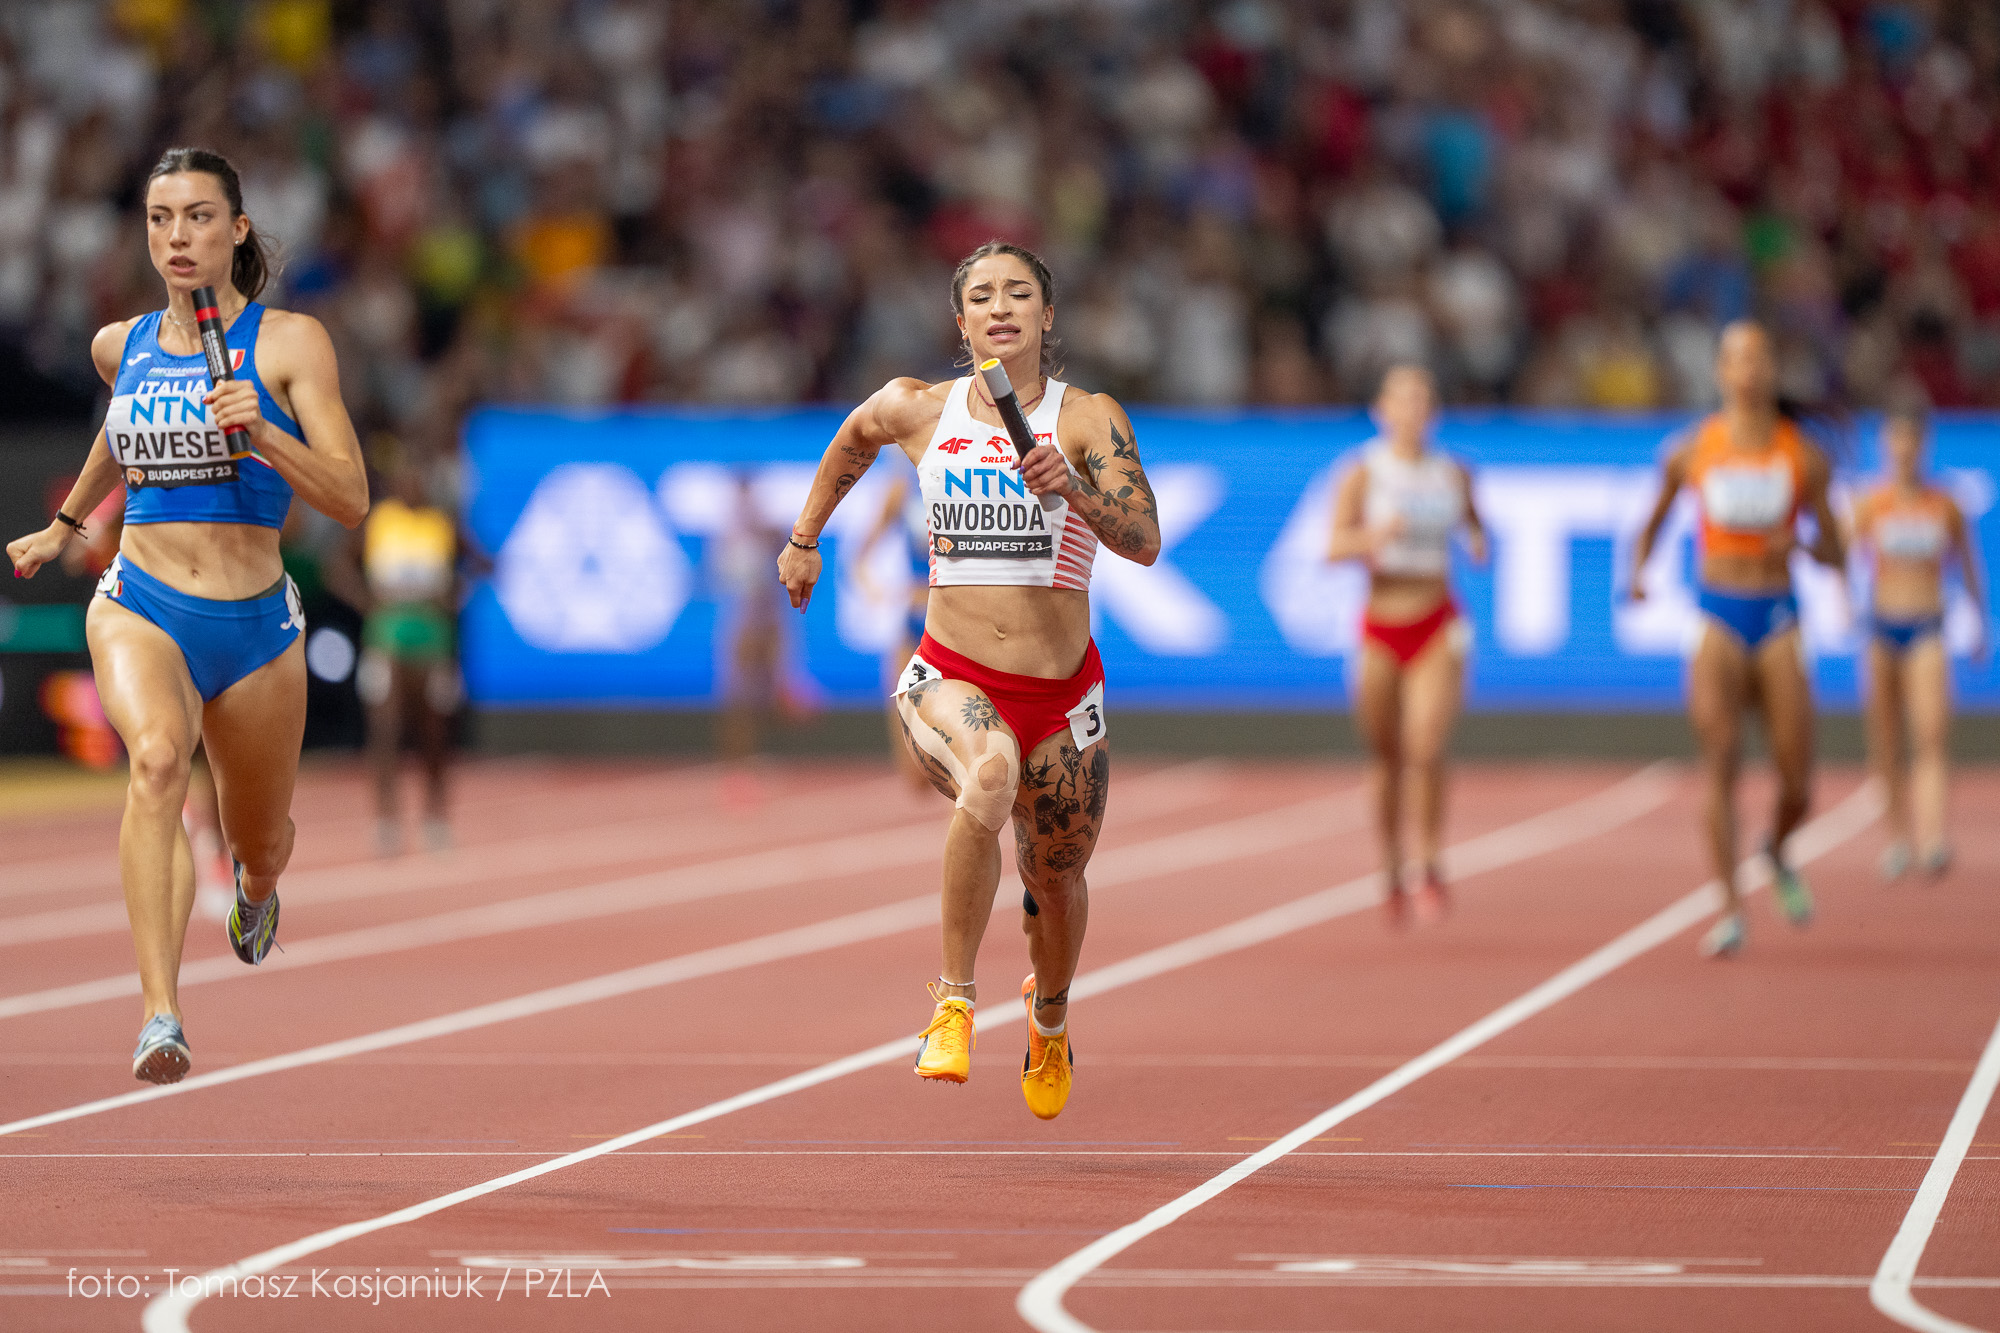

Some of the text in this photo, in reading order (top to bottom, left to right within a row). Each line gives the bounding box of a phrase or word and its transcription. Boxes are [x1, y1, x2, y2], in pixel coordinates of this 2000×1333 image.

[135, 380, 208, 396] ITALIA
[130, 396, 206, 425] NTN
[116, 431, 223, 460] PAVESE
[938, 437, 973, 454] 4F
[980, 455, 1012, 463] ORLEN
[148, 465, 232, 481] BUDAPEST 23
[945, 468, 1025, 499] NTN
[932, 503, 1045, 531] SWOBODA
[957, 541, 1043, 552] BUDAPEST 23
[1085, 704, 1101, 737] 3
